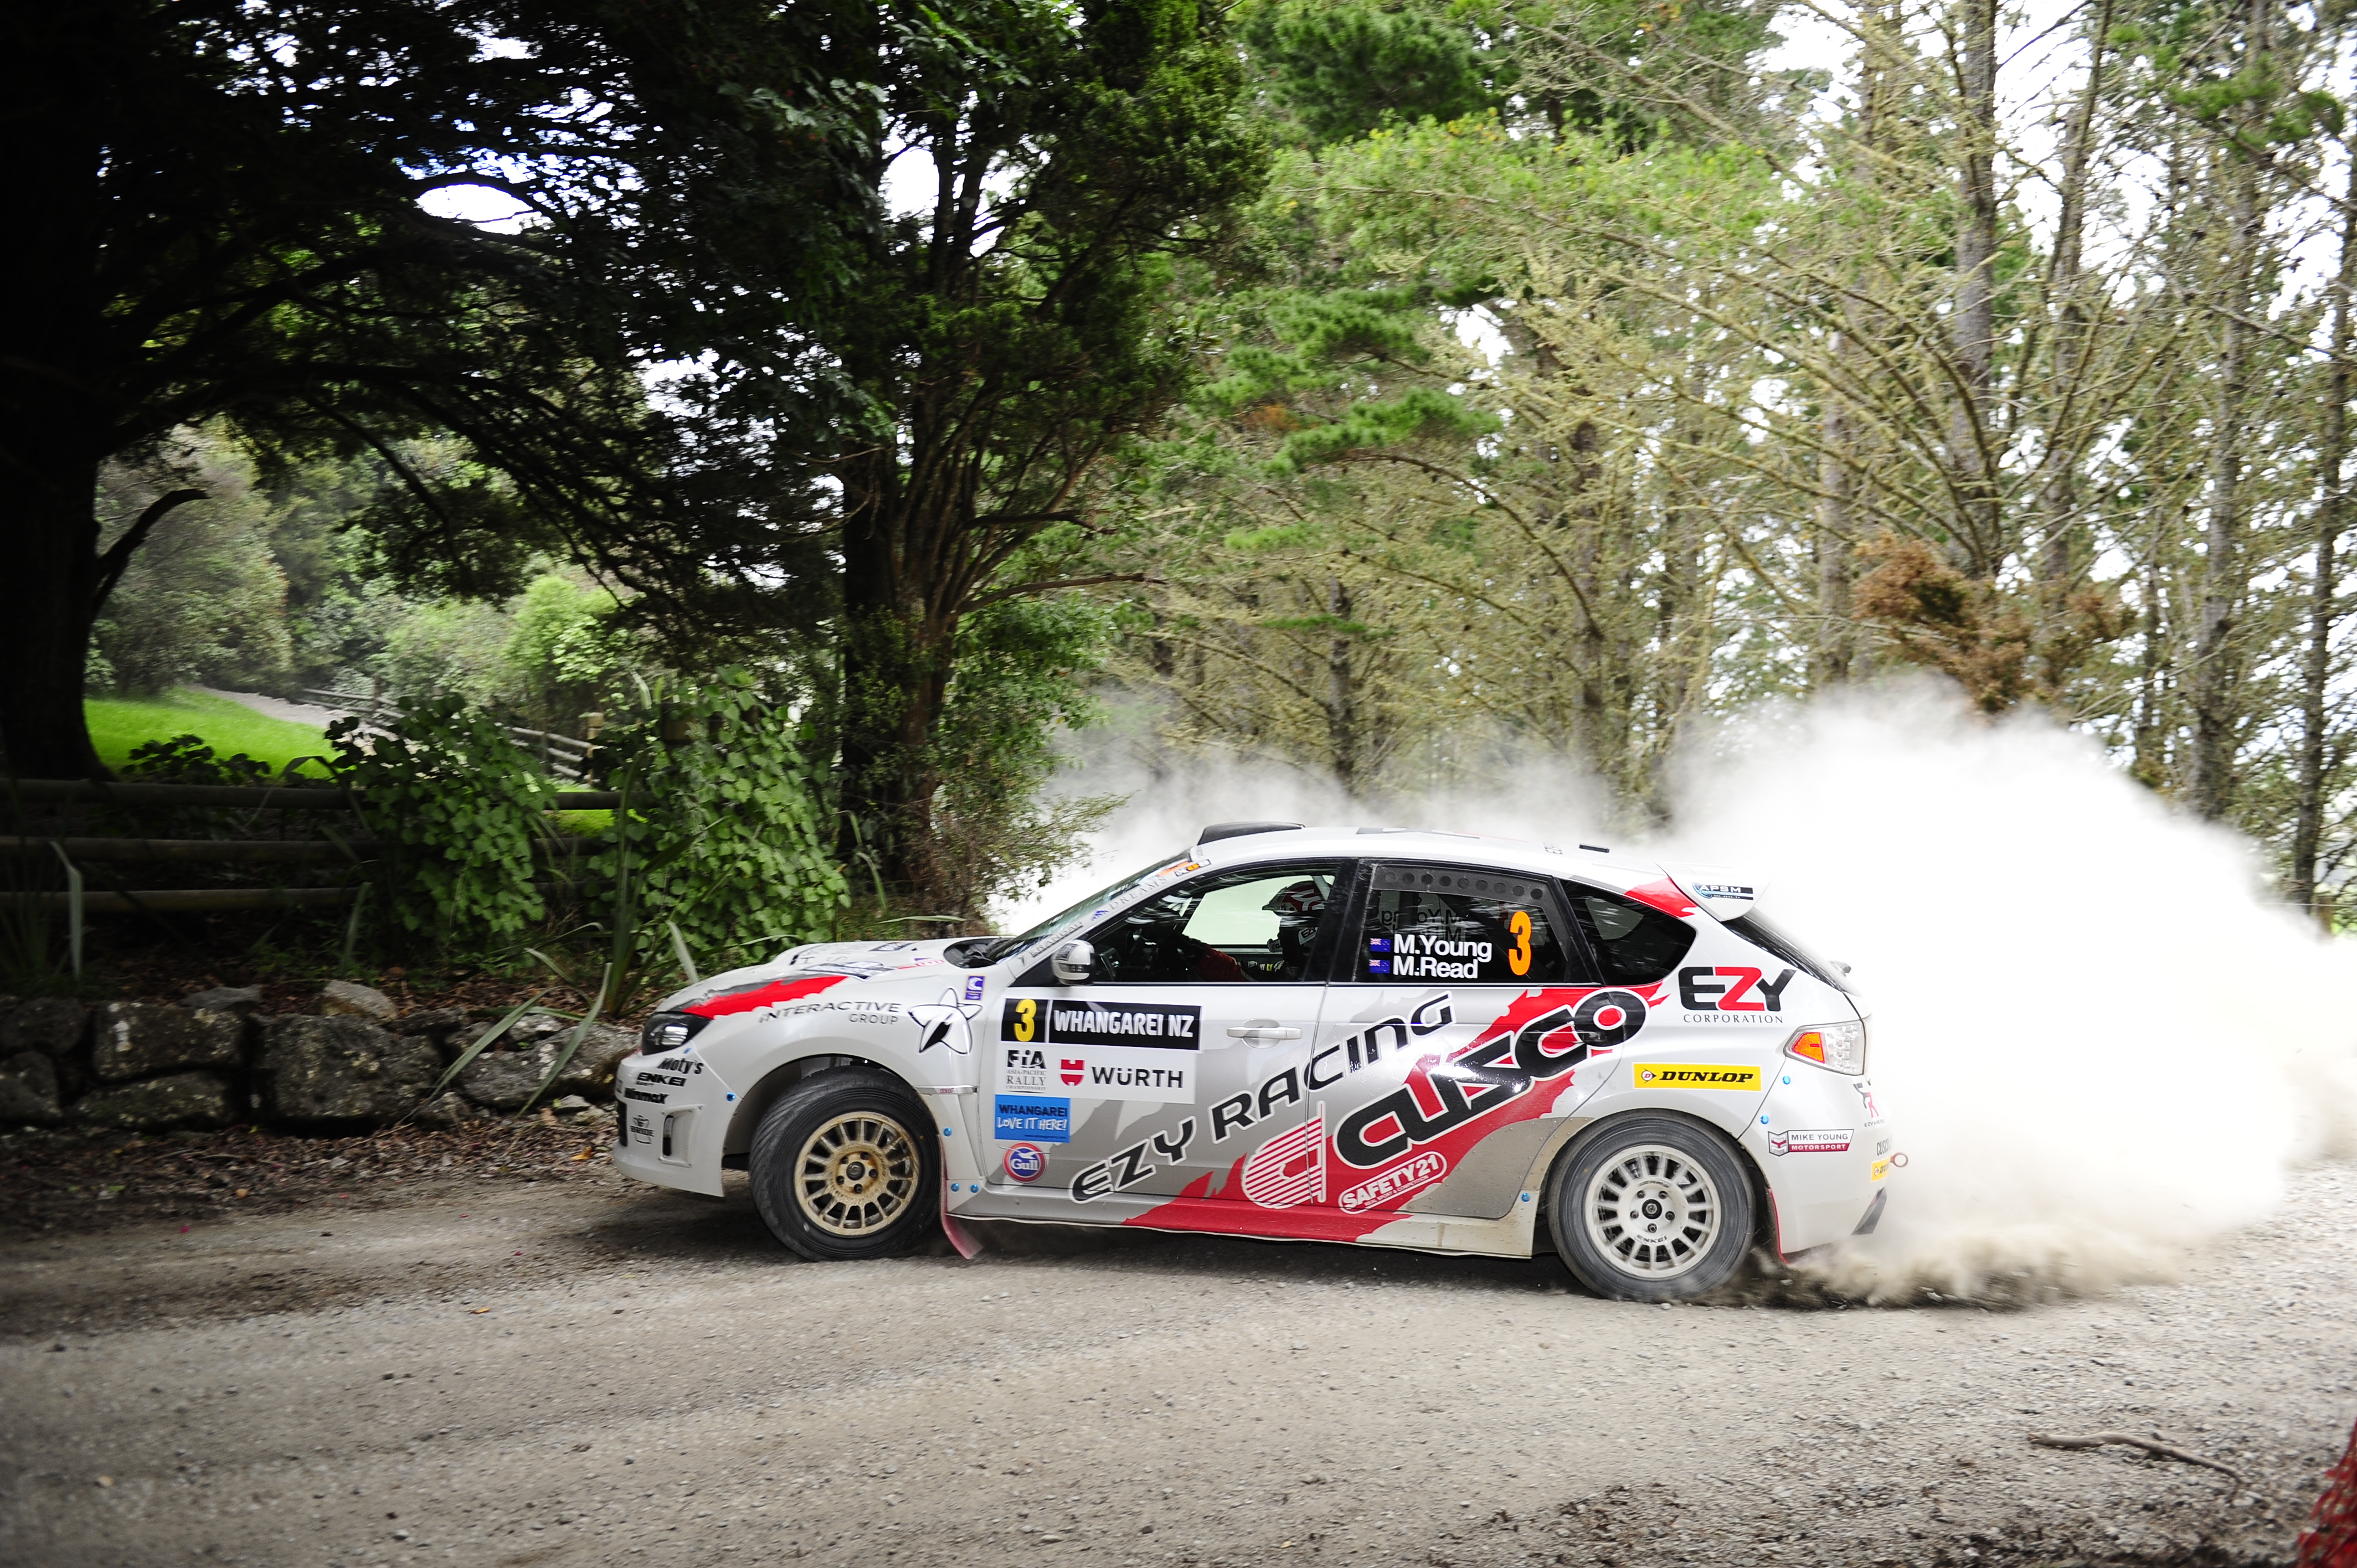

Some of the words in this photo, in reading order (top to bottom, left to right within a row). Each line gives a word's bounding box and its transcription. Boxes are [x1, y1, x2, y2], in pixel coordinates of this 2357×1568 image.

[1109, 877, 1168, 910] DREAMS
[1393, 933, 1493, 963] M.Young
[1509, 910, 1532, 976] 3
[1393, 955, 1478, 979] M.Read
[1678, 966, 1797, 1012] EZY
[758, 1000, 902, 1024] INTERACTIVE
[849, 1013, 898, 1025] GROUP
[1013, 998, 1037, 1042] 3
[1053, 1009, 1165, 1036] WHANGAREI
[1167, 1014, 1195, 1038] NZ
[1683, 1014, 1783, 1024] CORPORATION
[656, 1058, 704, 1075] Moty's
[637, 1072, 687, 1087] ENKEI
[1006, 1075, 1047, 1086] RALLY
[1659, 1071, 1754, 1083] DUNLOP
[1071, 1117, 1195, 1202] EZY
[1212, 993, 1452, 1142] RACING
[999, 1104, 1068, 1117] WHANGAREI
[630, 1125, 655, 1137] BRIDE
[997, 1116, 1023, 1129] LOVE
[1025, 1117, 1039, 1129] IT
[1038, 1118, 1068, 1131] HERE!
[1011, 1158, 1039, 1170] Gull
[1364, 1198, 1378, 1206] REAL
[1377, 1191, 1393, 1200] SPORT
[1397, 1174, 1429, 1192] COMPETITION
